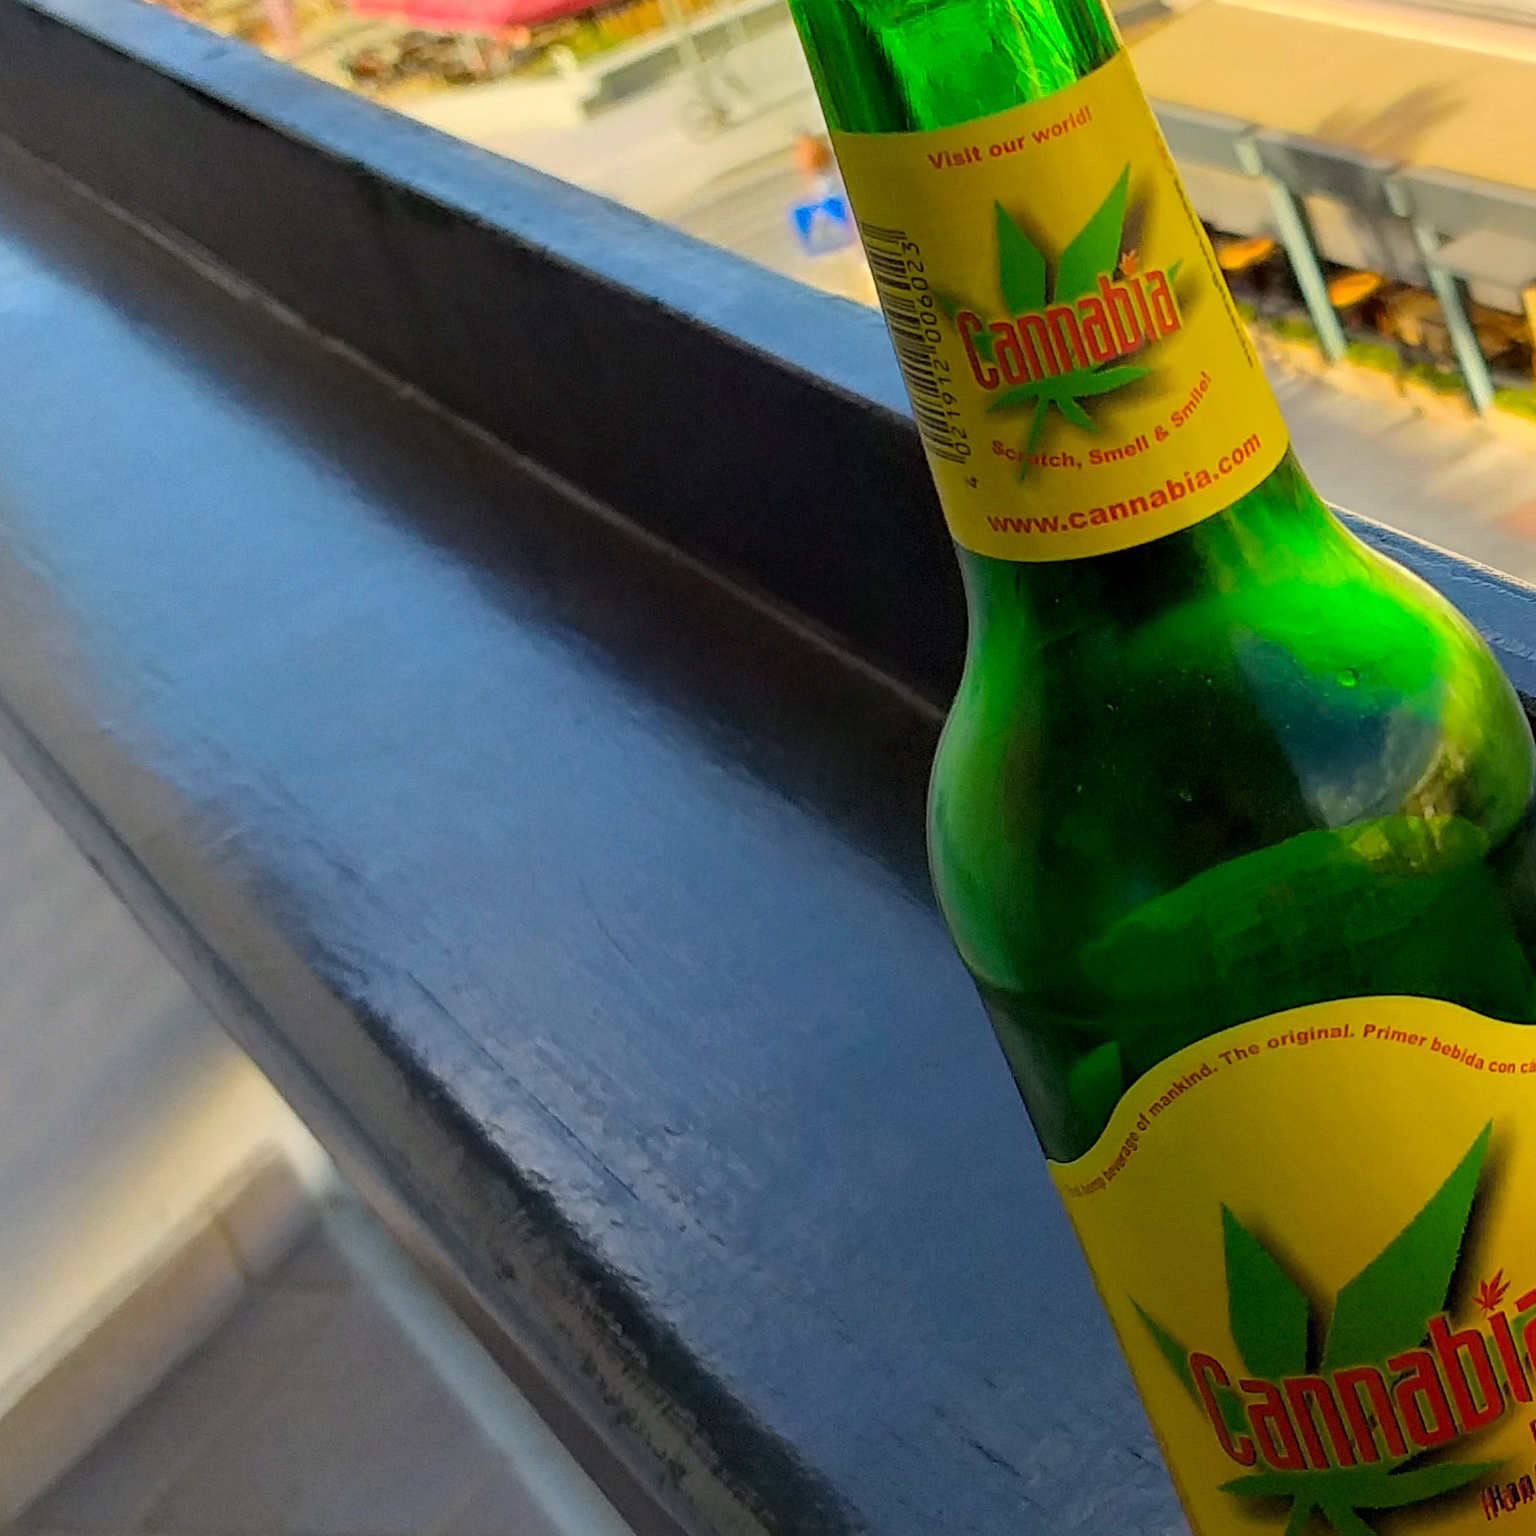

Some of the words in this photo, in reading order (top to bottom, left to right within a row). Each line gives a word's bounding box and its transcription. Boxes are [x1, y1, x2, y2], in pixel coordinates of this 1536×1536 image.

[928, 147, 983, 171] Visit
[989, 135, 1027, 159] our
[1031, 105, 1094, 145] world!
[956, 254, 1182, 392] Cannabia
[991, 439, 1083, 469] Scratch,
[1088, 435, 1149, 466] Smell
[1153, 424, 1170, 444] &
[1170, 370, 1213, 429] Smile!
[986, 433, 1262, 534] www.cannabia.com
[1136, 1112, 1151, 1132] of
[1148, 1062, 1219, 1117] mankind.
[1218, 1043, 1261, 1066] The
[1267, 1023, 1355, 1050] original.
[1362, 1023, 1427, 1048] Primer
[1430, 1035, 1485, 1072] bebida
[1488, 1060, 1516, 1074] con
